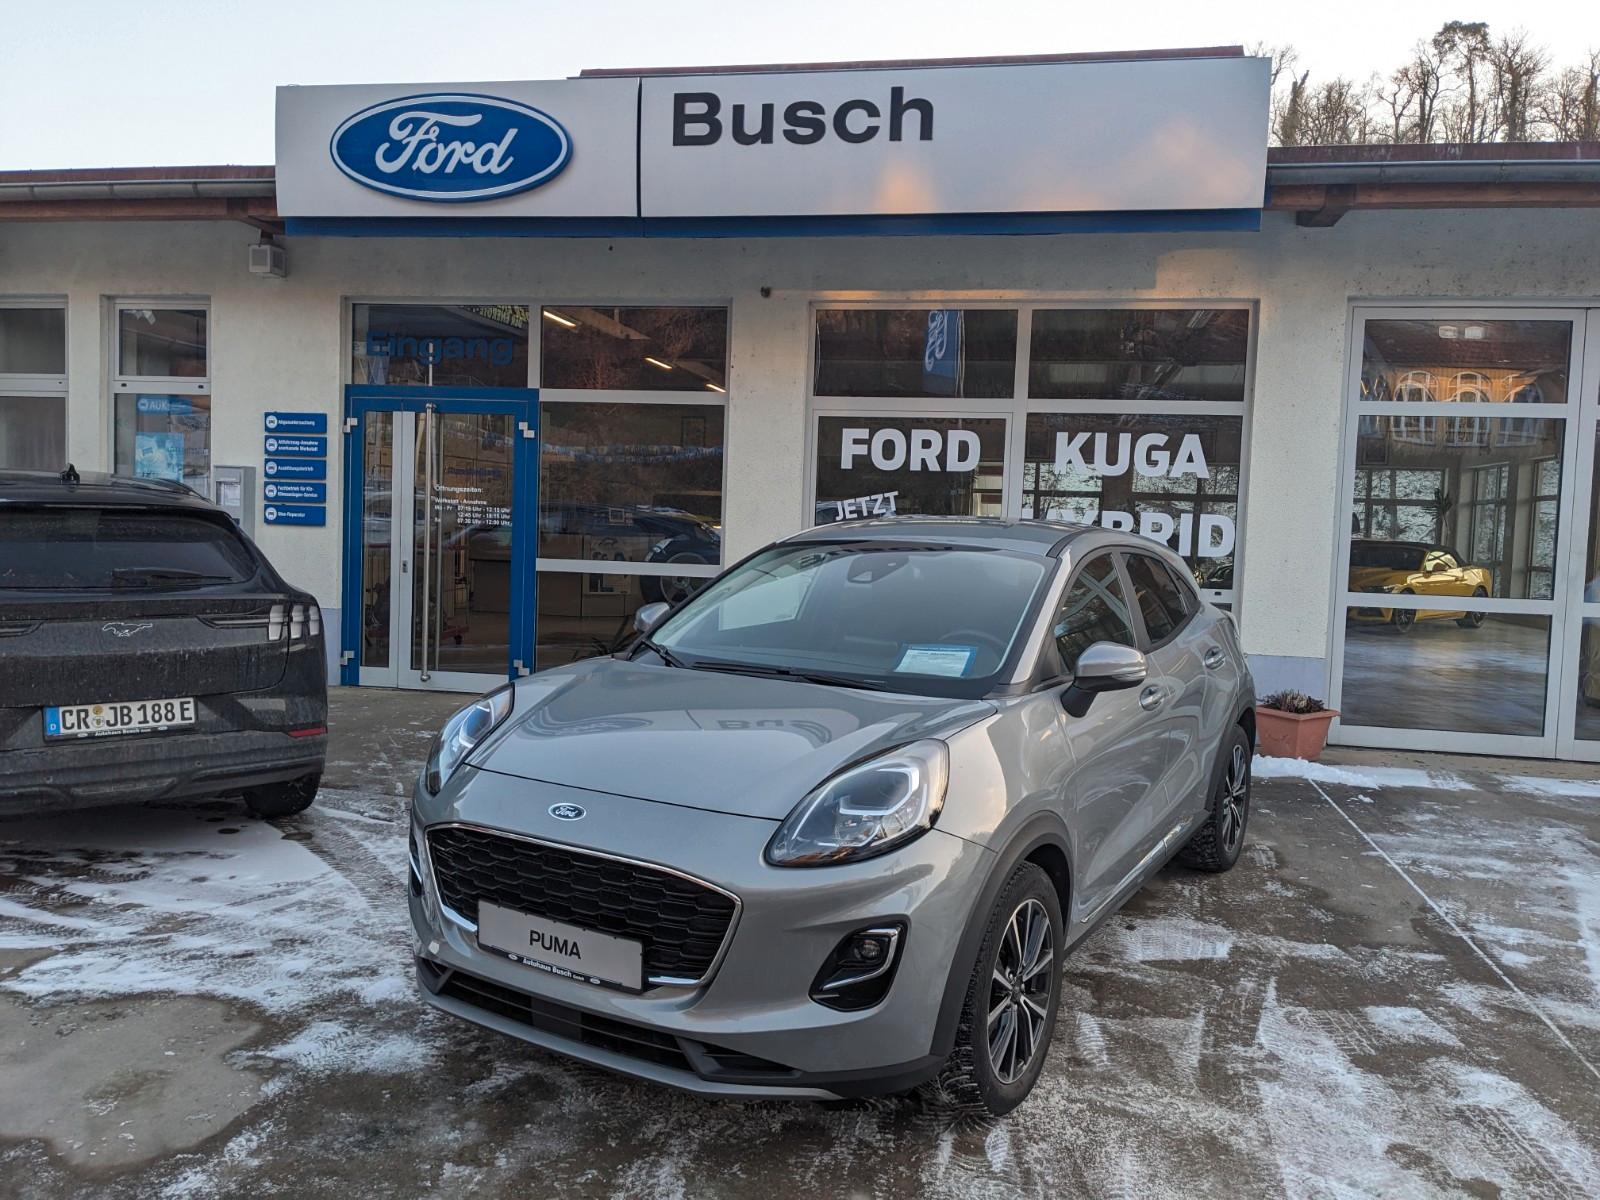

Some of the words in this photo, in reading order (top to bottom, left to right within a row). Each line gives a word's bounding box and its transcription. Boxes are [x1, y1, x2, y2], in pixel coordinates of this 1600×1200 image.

[672, 86, 934, 146] Busch
[375, 111, 519, 174] Ford
[366, 330, 513, 366] Eingang
[841, 428, 981, 472] FORD
[1054, 431, 1210, 480] KUGA
[835, 490, 899, 521] JETZT
[62, 708, 90, 730] CR
[106, 705, 132, 727] JB
[529, 930, 582, 960] PUMA
[522, 957, 551, 972] Autohaus
[552, 966, 572, 978] Busch
